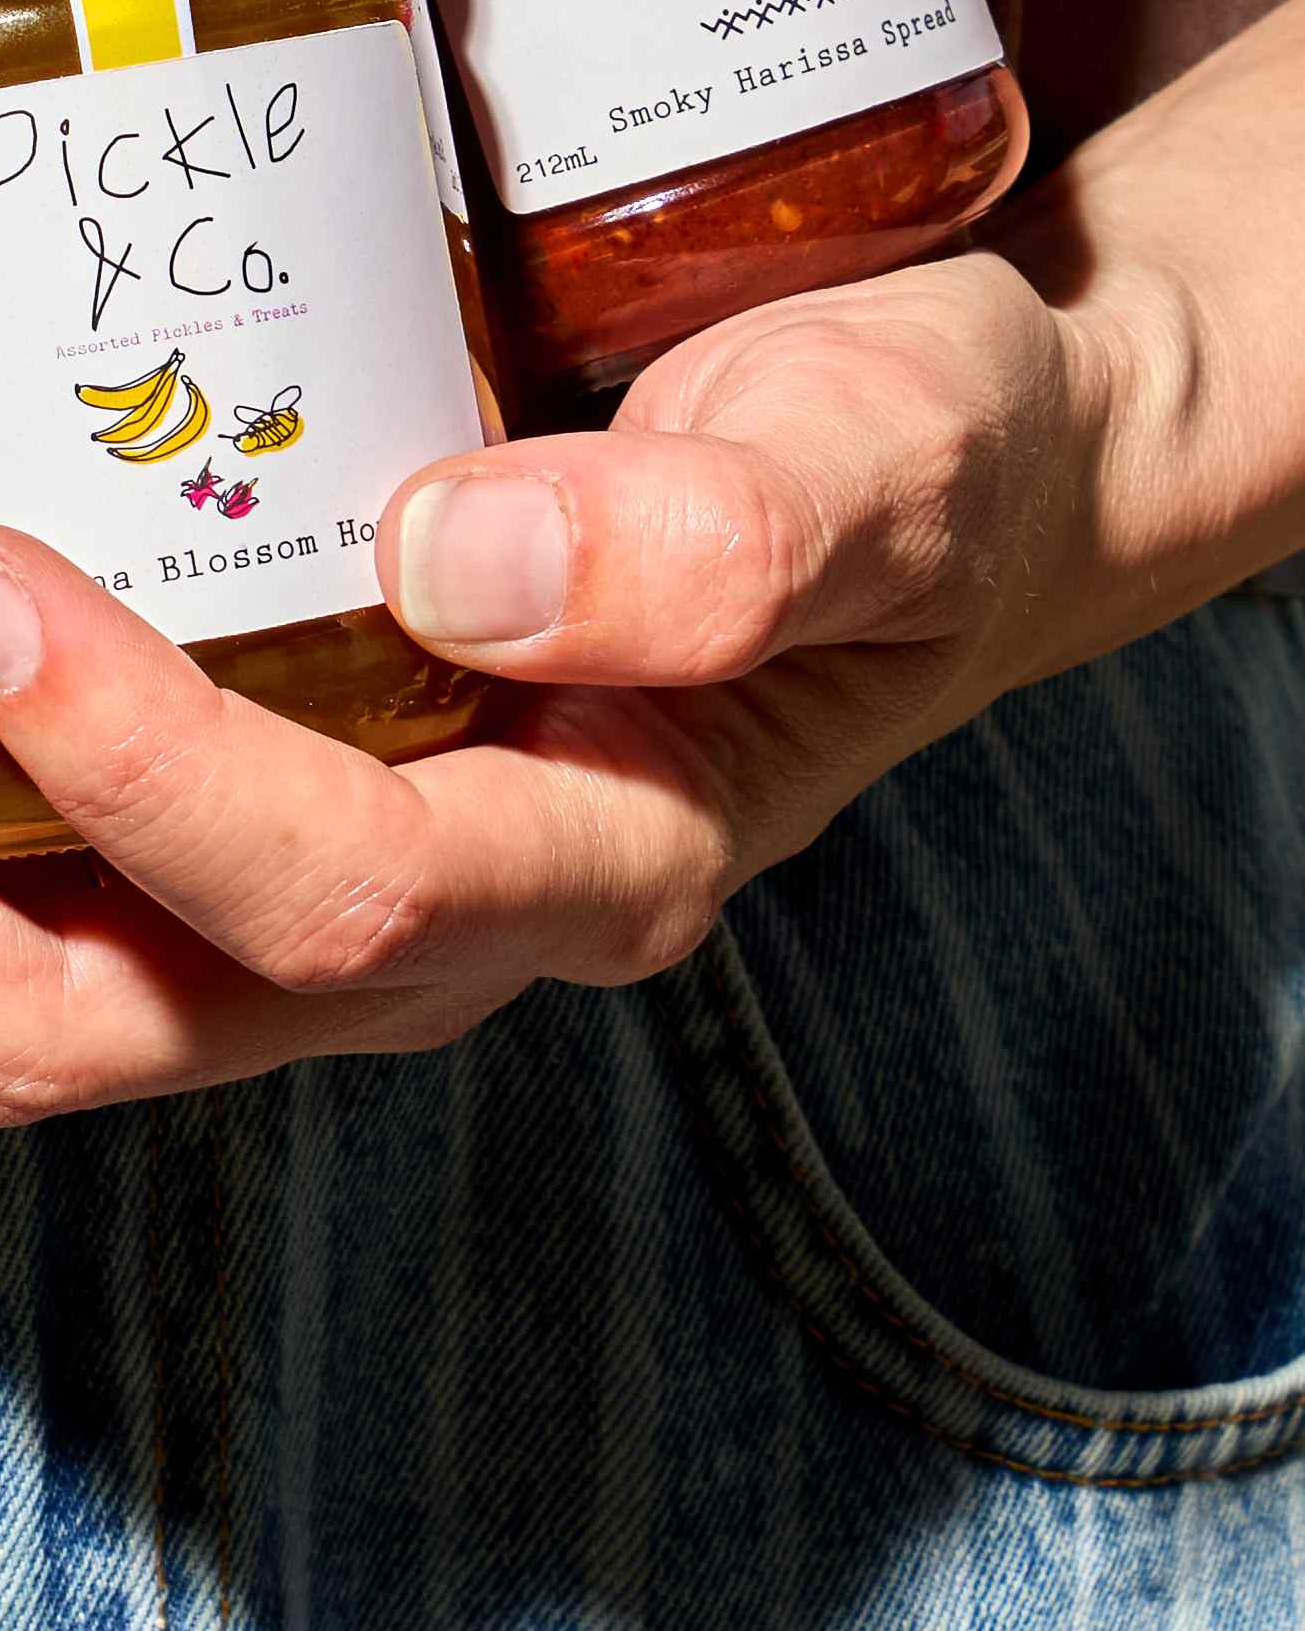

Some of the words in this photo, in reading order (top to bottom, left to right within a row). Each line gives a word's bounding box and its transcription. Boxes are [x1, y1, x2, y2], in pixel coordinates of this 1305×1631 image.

[608, 86, 713, 134] Smoky
[734, 37, 868, 95] Harissa
[517, 146, 598, 184] 212mL
[79, 217, 141, 331] &
[169, 217, 289, 296] Co.
[56, 332, 141, 360] Assorted
[152, 318, 224, 343] Pickles
[233, 313, 244, 326] &
[251, 303, 309, 324] Treats
[158, 534, 319, 583] Blossom
[336, 518, 380, 547] Ho
